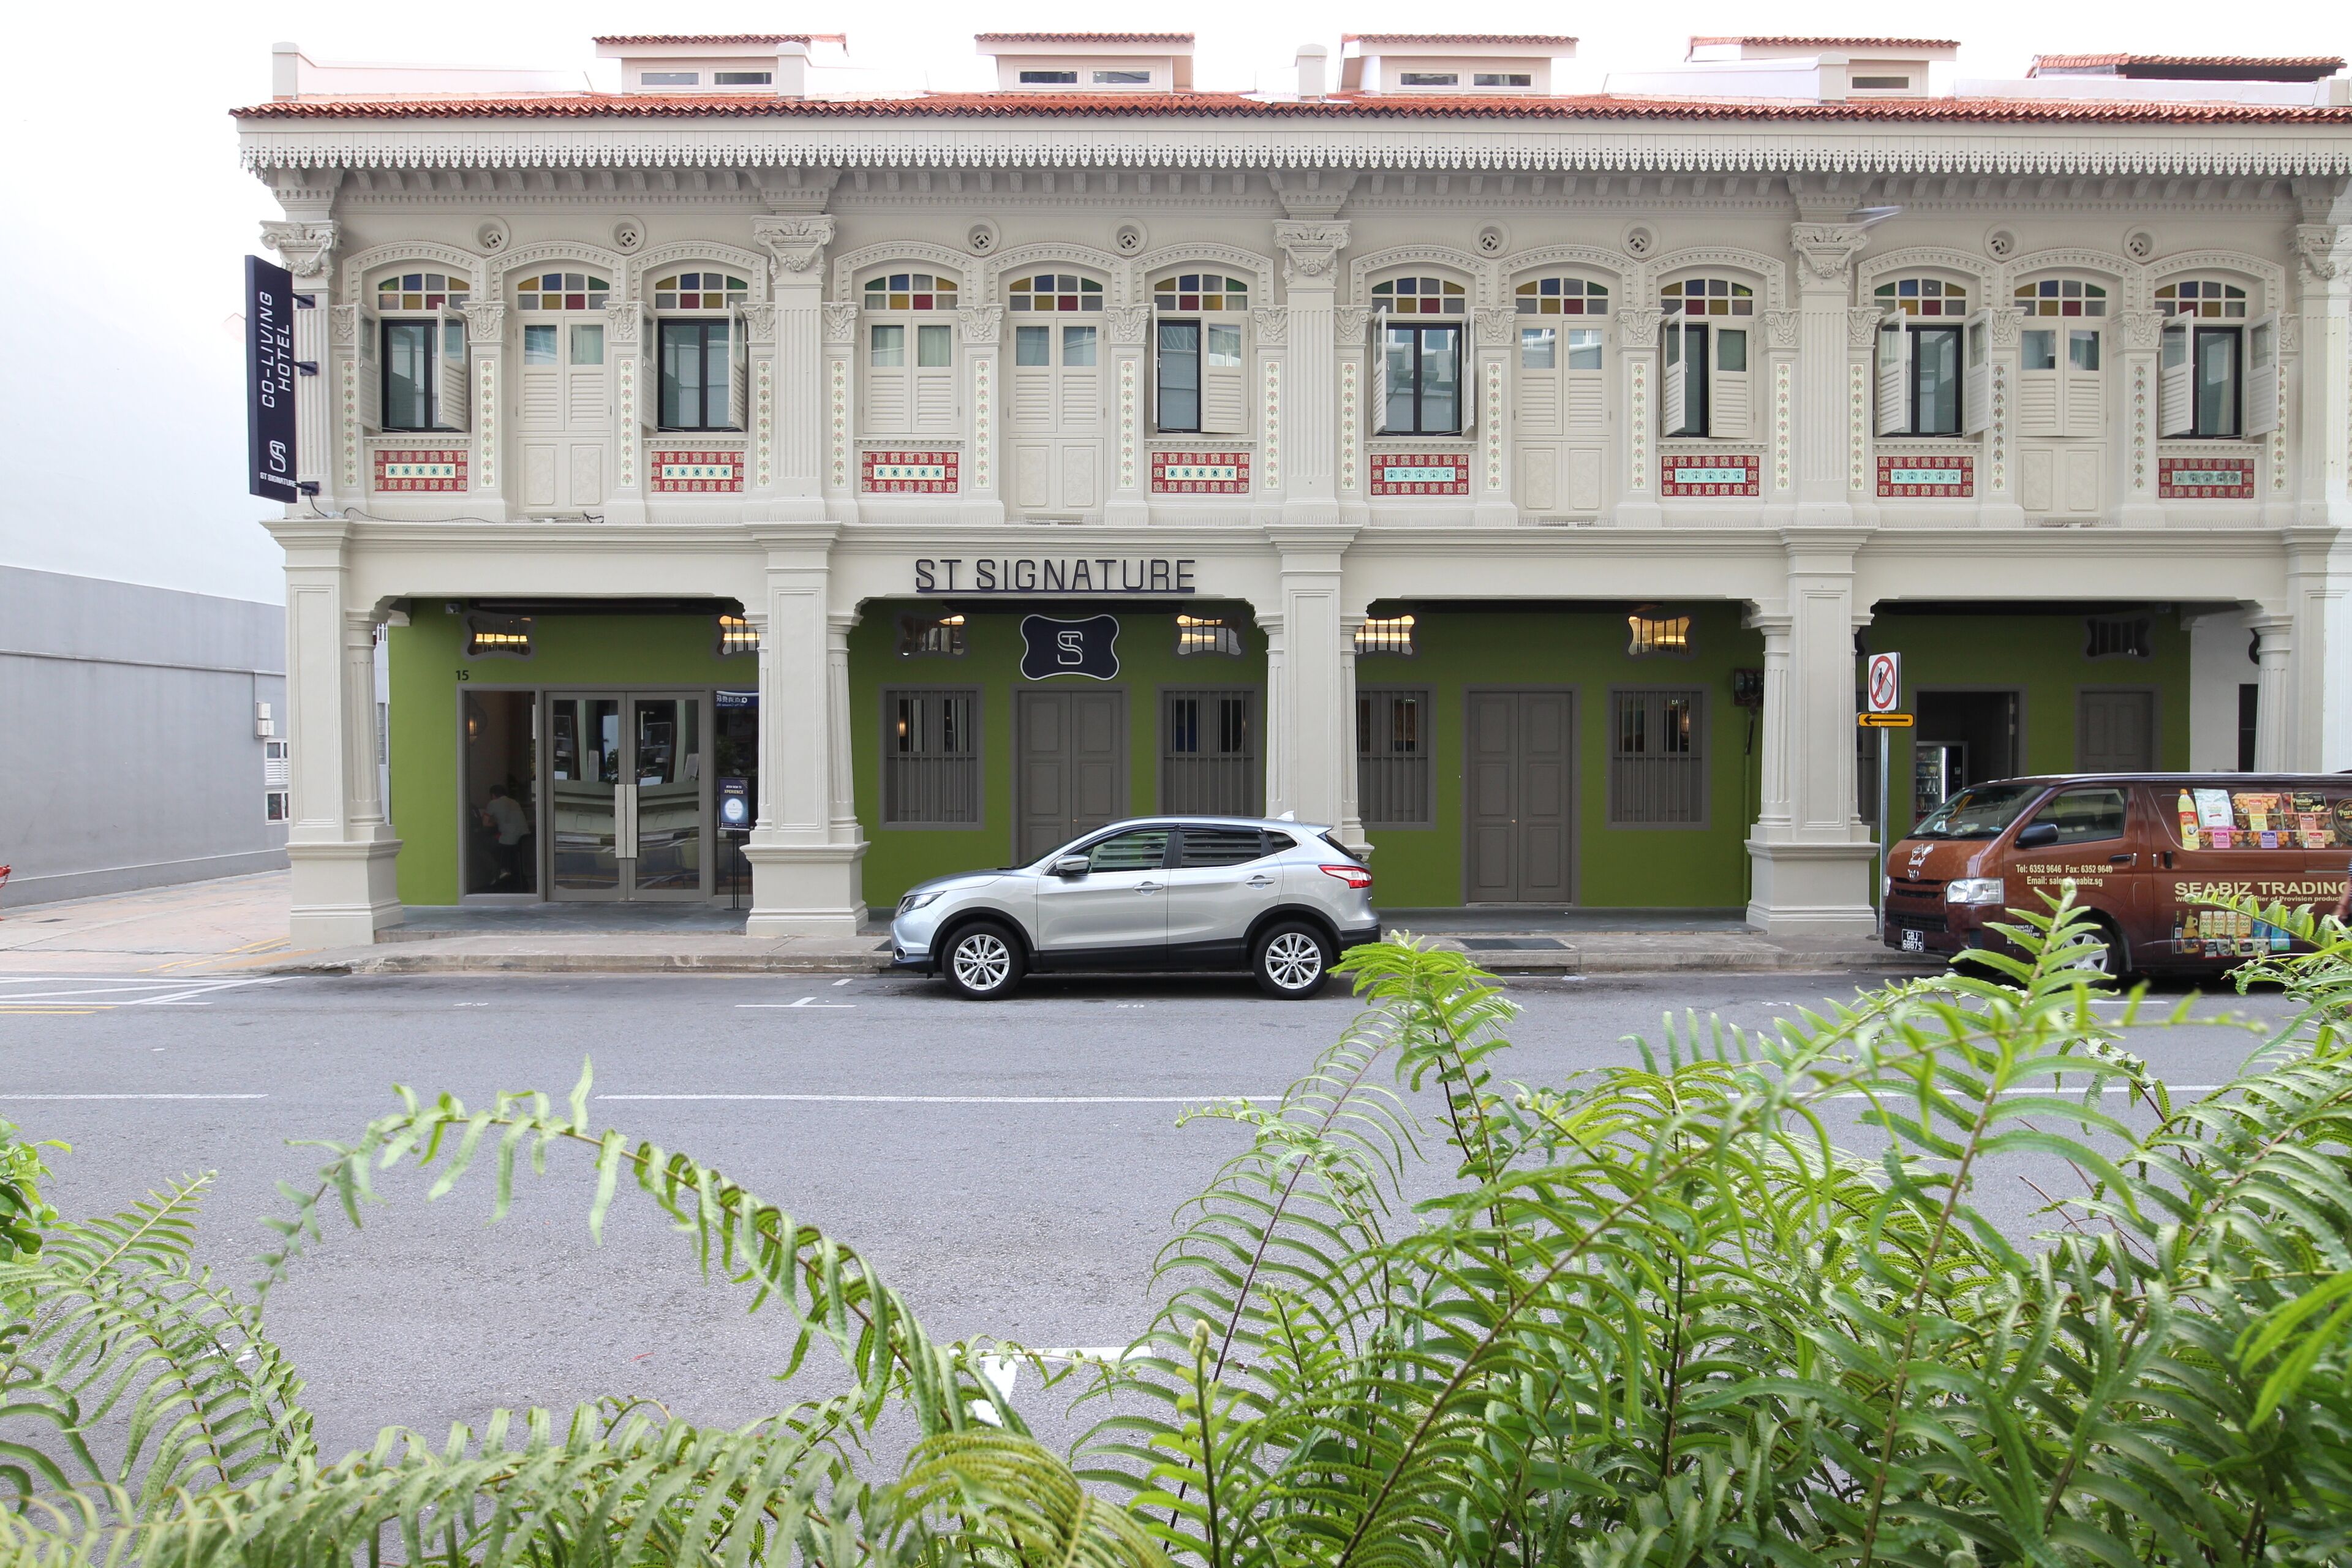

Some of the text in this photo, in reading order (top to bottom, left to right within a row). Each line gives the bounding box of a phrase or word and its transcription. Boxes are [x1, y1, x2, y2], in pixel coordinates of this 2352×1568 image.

[260, 292, 275, 409] CO-LIVING
[277, 324, 291, 392] HOTEL
[268, 474, 297, 488] SIGNATURE
[916, 559, 1196, 590] ST SIGNATURE
[455, 669, 469, 680] 15
[2016, 864, 2027, 873] Tel:
[2046, 865, 2062, 873] 9646
[2065, 865, 2079, 873] Fax:
[2081, 865, 2096, 873] 6352
[2097, 865, 2113, 873] 9640
[2049, 876, 2103, 886] saleeabiz.sg
[2174, 882, 2253, 895] SEABIZ
[1906, 931, 1918, 940] GBJ
[1902, 940, 1923, 951] 6887S
